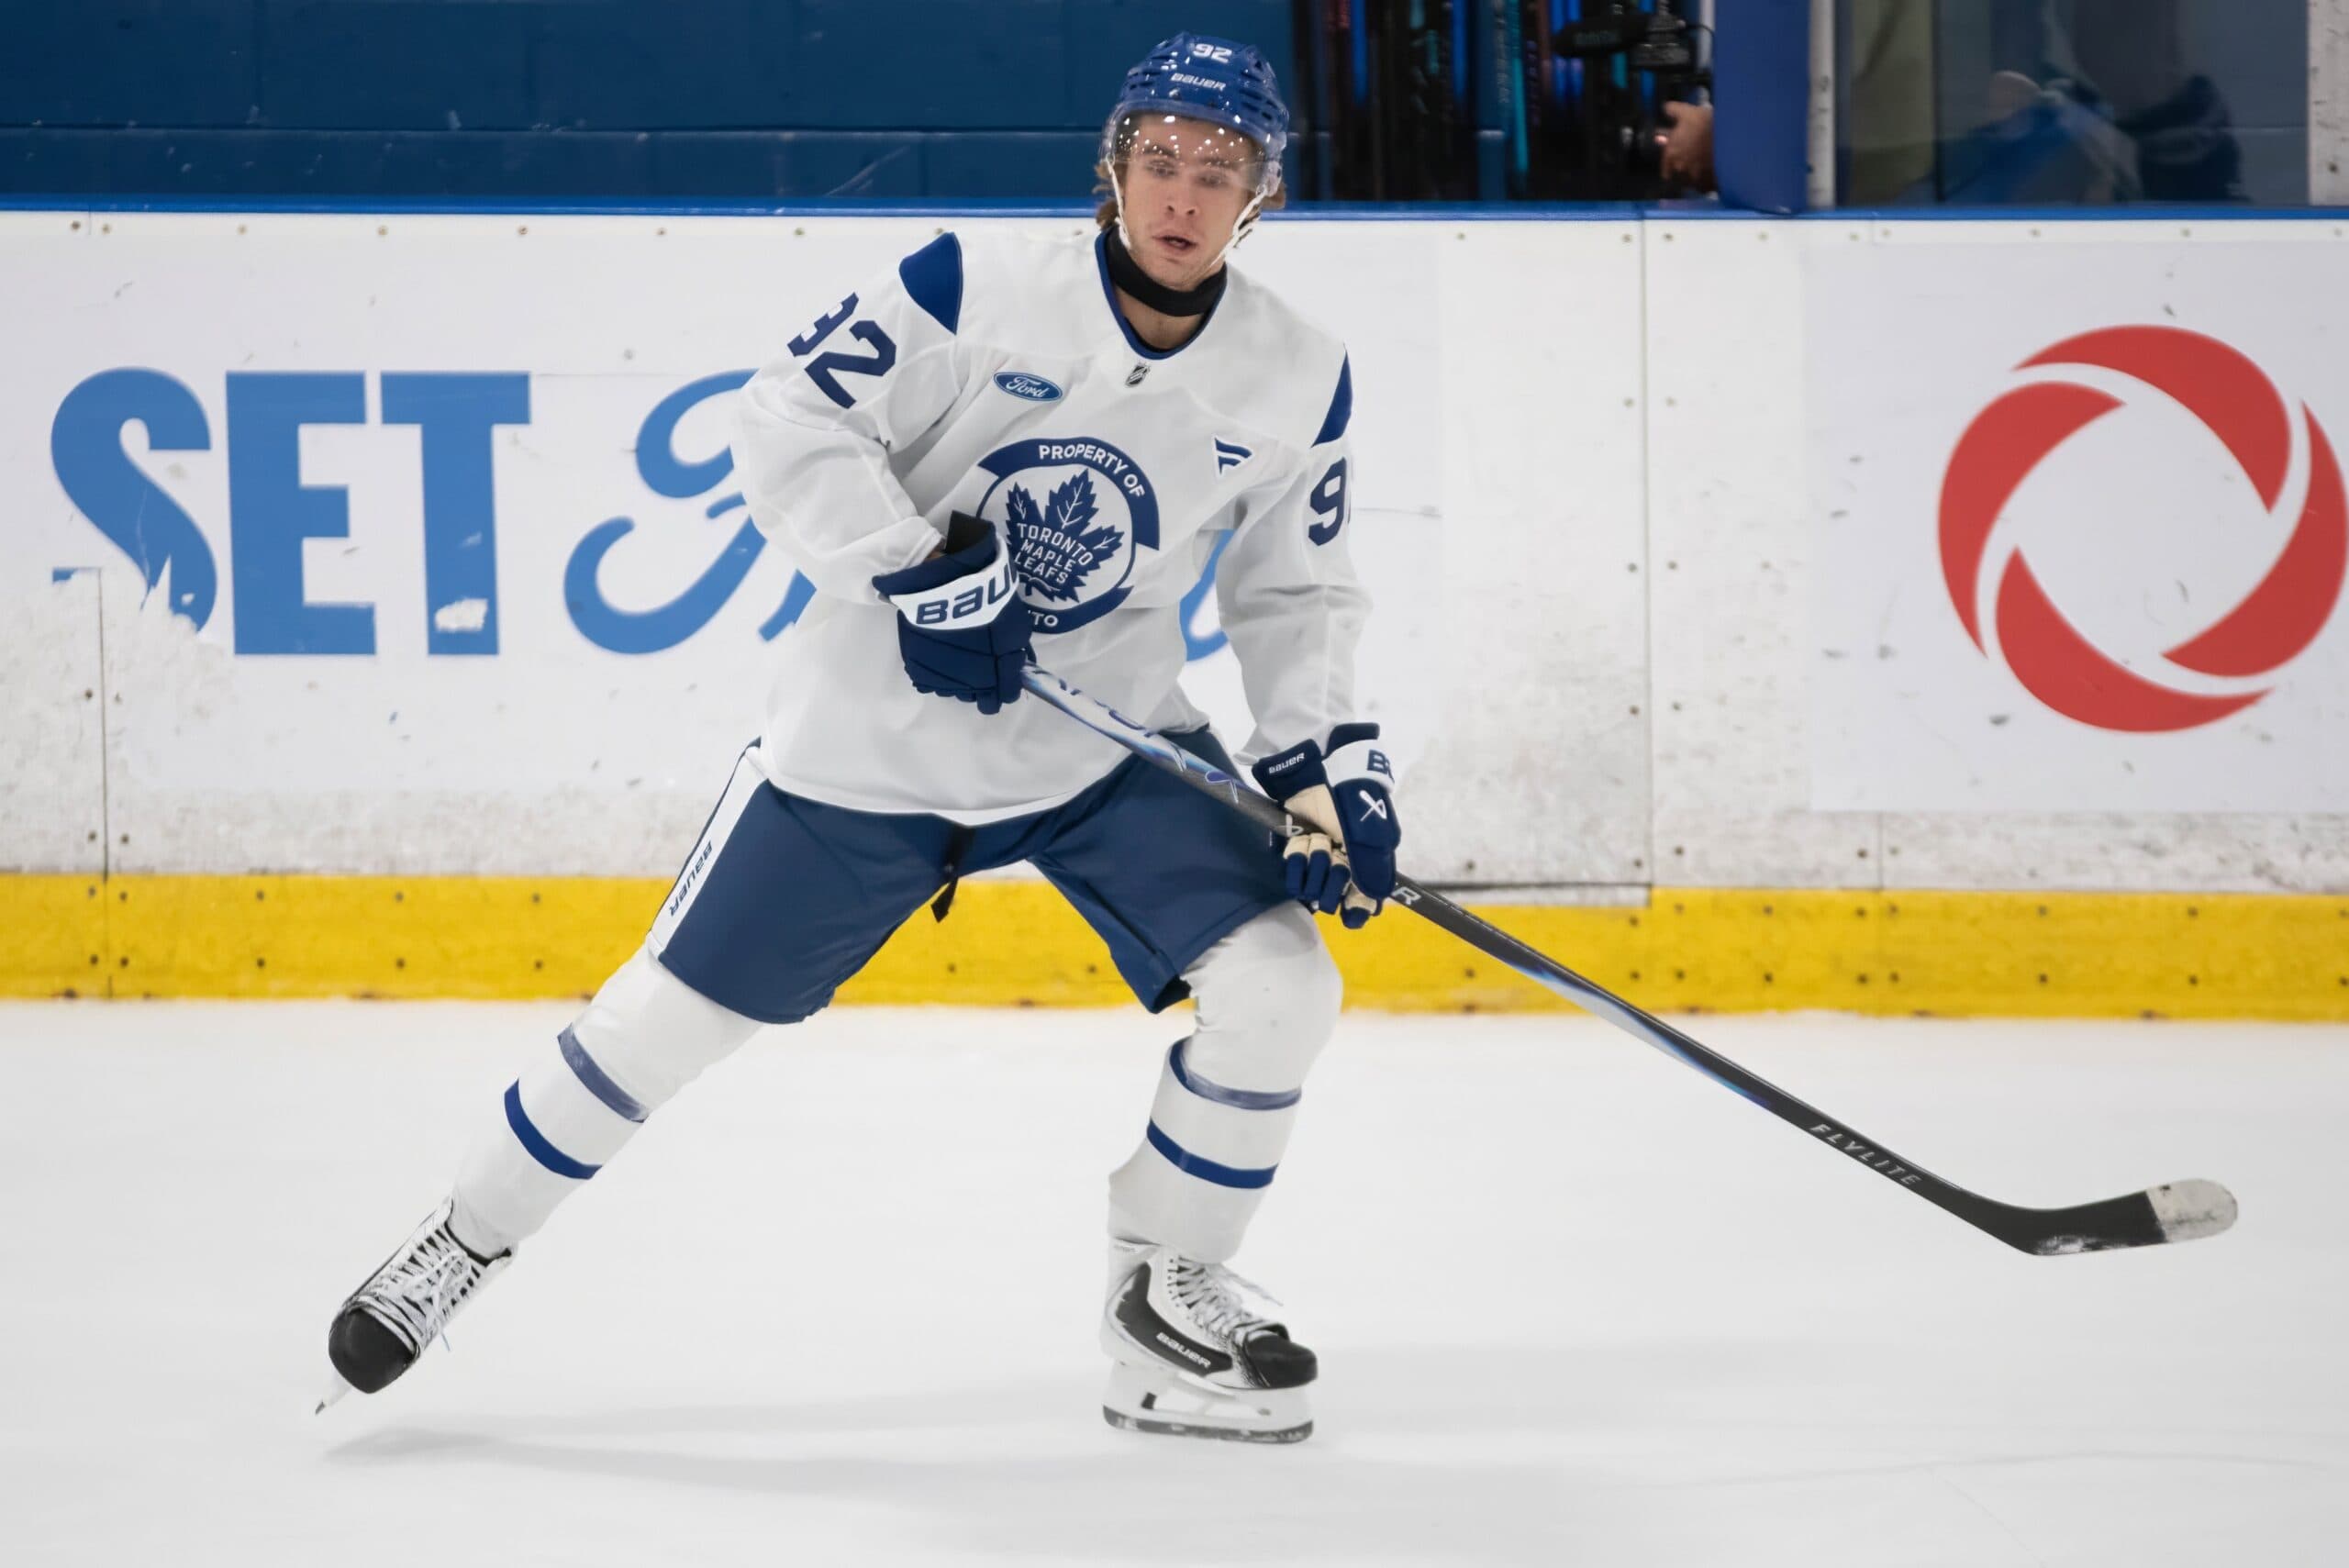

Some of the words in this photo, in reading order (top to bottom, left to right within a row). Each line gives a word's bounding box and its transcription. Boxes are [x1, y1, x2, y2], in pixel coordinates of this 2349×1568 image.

[1193, 43, 1232, 64] 92
[1006, 376, 1051, 398] Ford
[1039, 444, 1129, 474] PROPERTY
[1123, 473, 1145, 498] OF
[51, 366, 531, 655] SET
[1308, 457, 1351, 546] 9
[1017, 523, 1094, 566] TORONTO
[1020, 539, 1078, 573] MAPLE
[1014, 551, 1069, 584] LEAFS
[1809, 1123, 1922, 1184] FLYLITE
